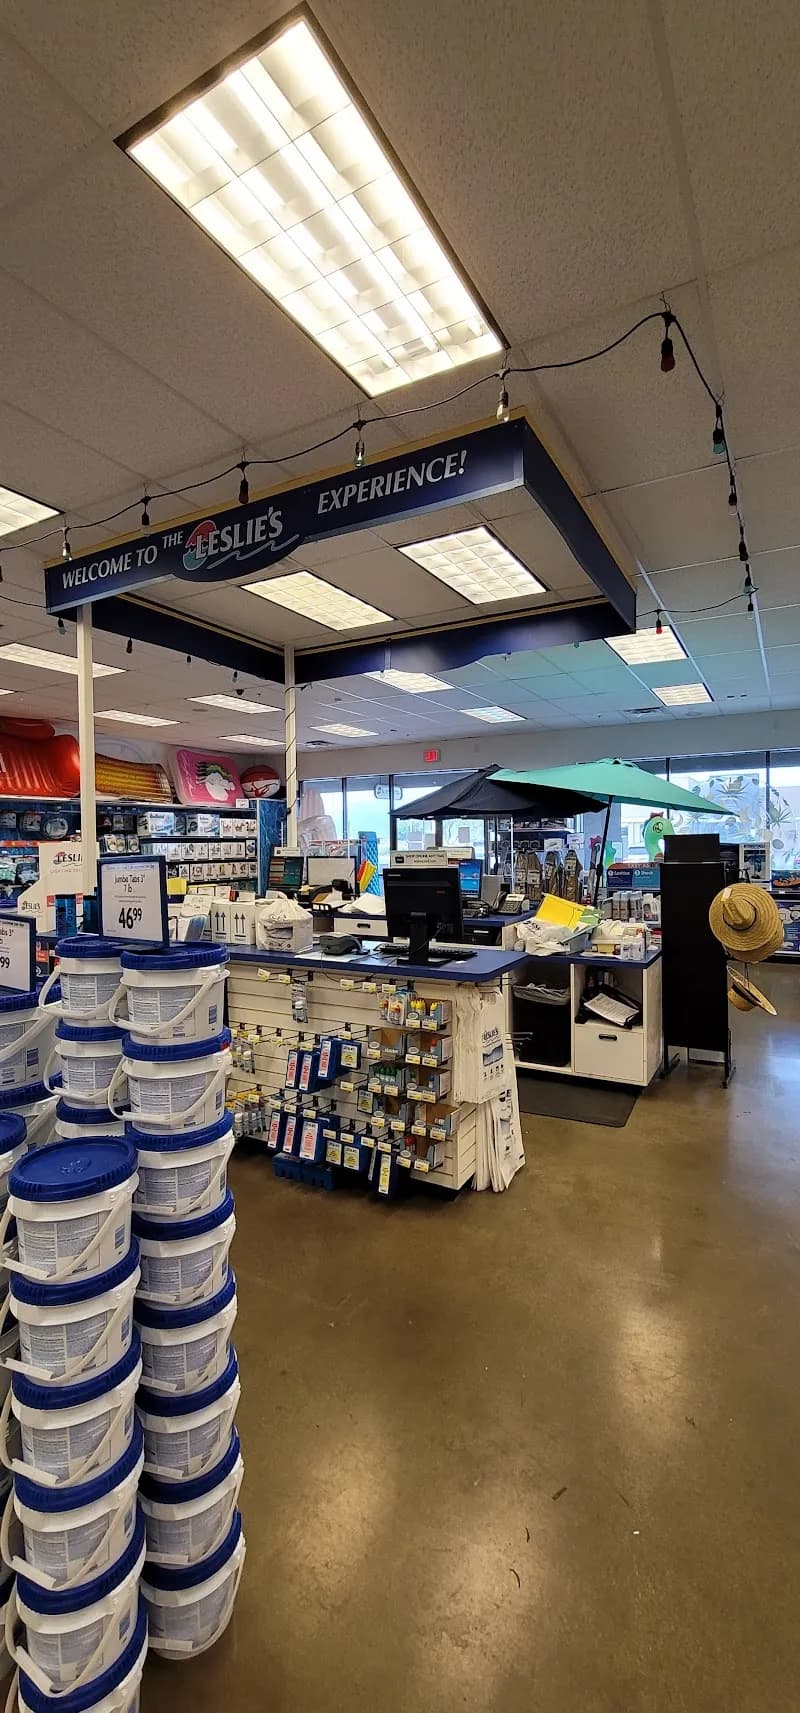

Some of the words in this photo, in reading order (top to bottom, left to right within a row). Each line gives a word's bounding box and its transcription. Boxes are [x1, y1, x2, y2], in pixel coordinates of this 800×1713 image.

[62, 551, 132, 589] WELCOME
[136, 545, 158, 568] TO
[162, 530, 184, 549] THE
[195, 506, 284, 560] LESLIE'S
[317, 449, 468, 515] EXPERIENCE!
